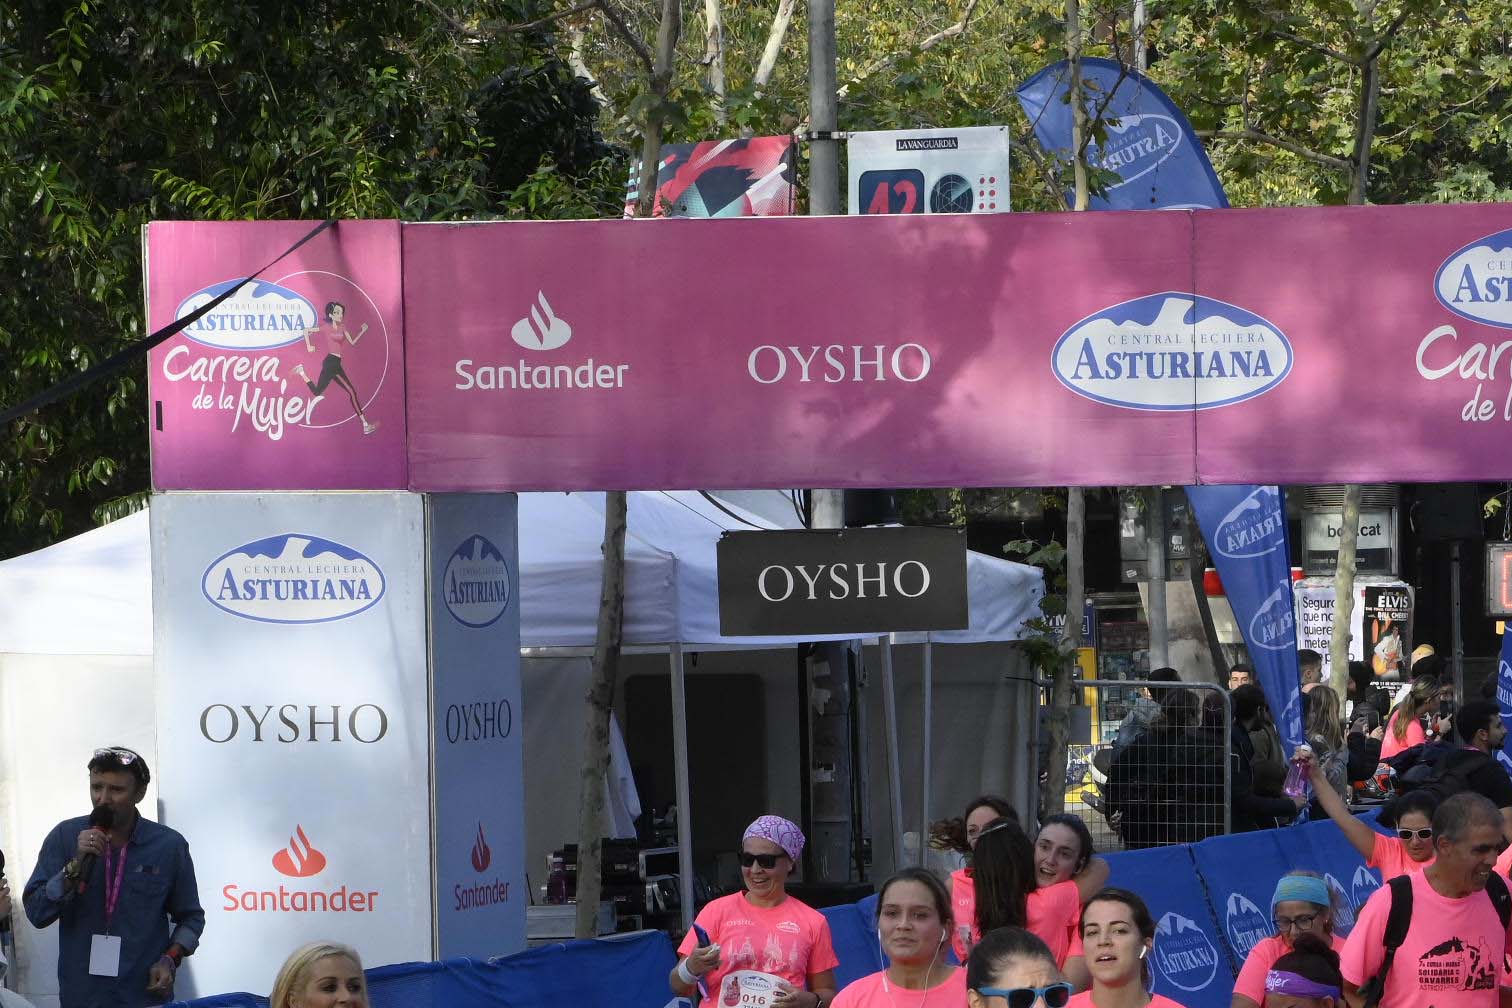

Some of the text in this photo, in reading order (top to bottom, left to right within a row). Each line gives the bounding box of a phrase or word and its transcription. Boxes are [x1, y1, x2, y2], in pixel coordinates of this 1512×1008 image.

[907, 137, 957, 149] VANGUARDIA
[1108, 332, 1266, 346] CENTRAL LECHERA
[163, 345, 280, 382] Carrera
[455, 358, 628, 390] Santander
[747, 342, 932, 384] OYSHO
[1071, 337, 1274, 379] ASTURIANA
[192, 378, 325, 441] de la Mujer
[1461, 383, 1496, 422] de
[216, 569, 372, 601] ASTURIANA
[244, 565, 366, 574] CENTRAL LECHERA
[757, 560, 931, 602] OYSHO
[449, 570, 506, 604] ASTURIANA
[1378, 595, 1408, 608] ELVIS
[1303, 612, 1319, 624] que
[1304, 626, 1333, 636] quiere
[199, 703, 389, 744] OYSHO
[446, 699, 512, 744] OYSHO
[222, 884, 378, 912] Santander
[454, 878, 510, 912] Santander
[742, 993, 766, 1005] 016
